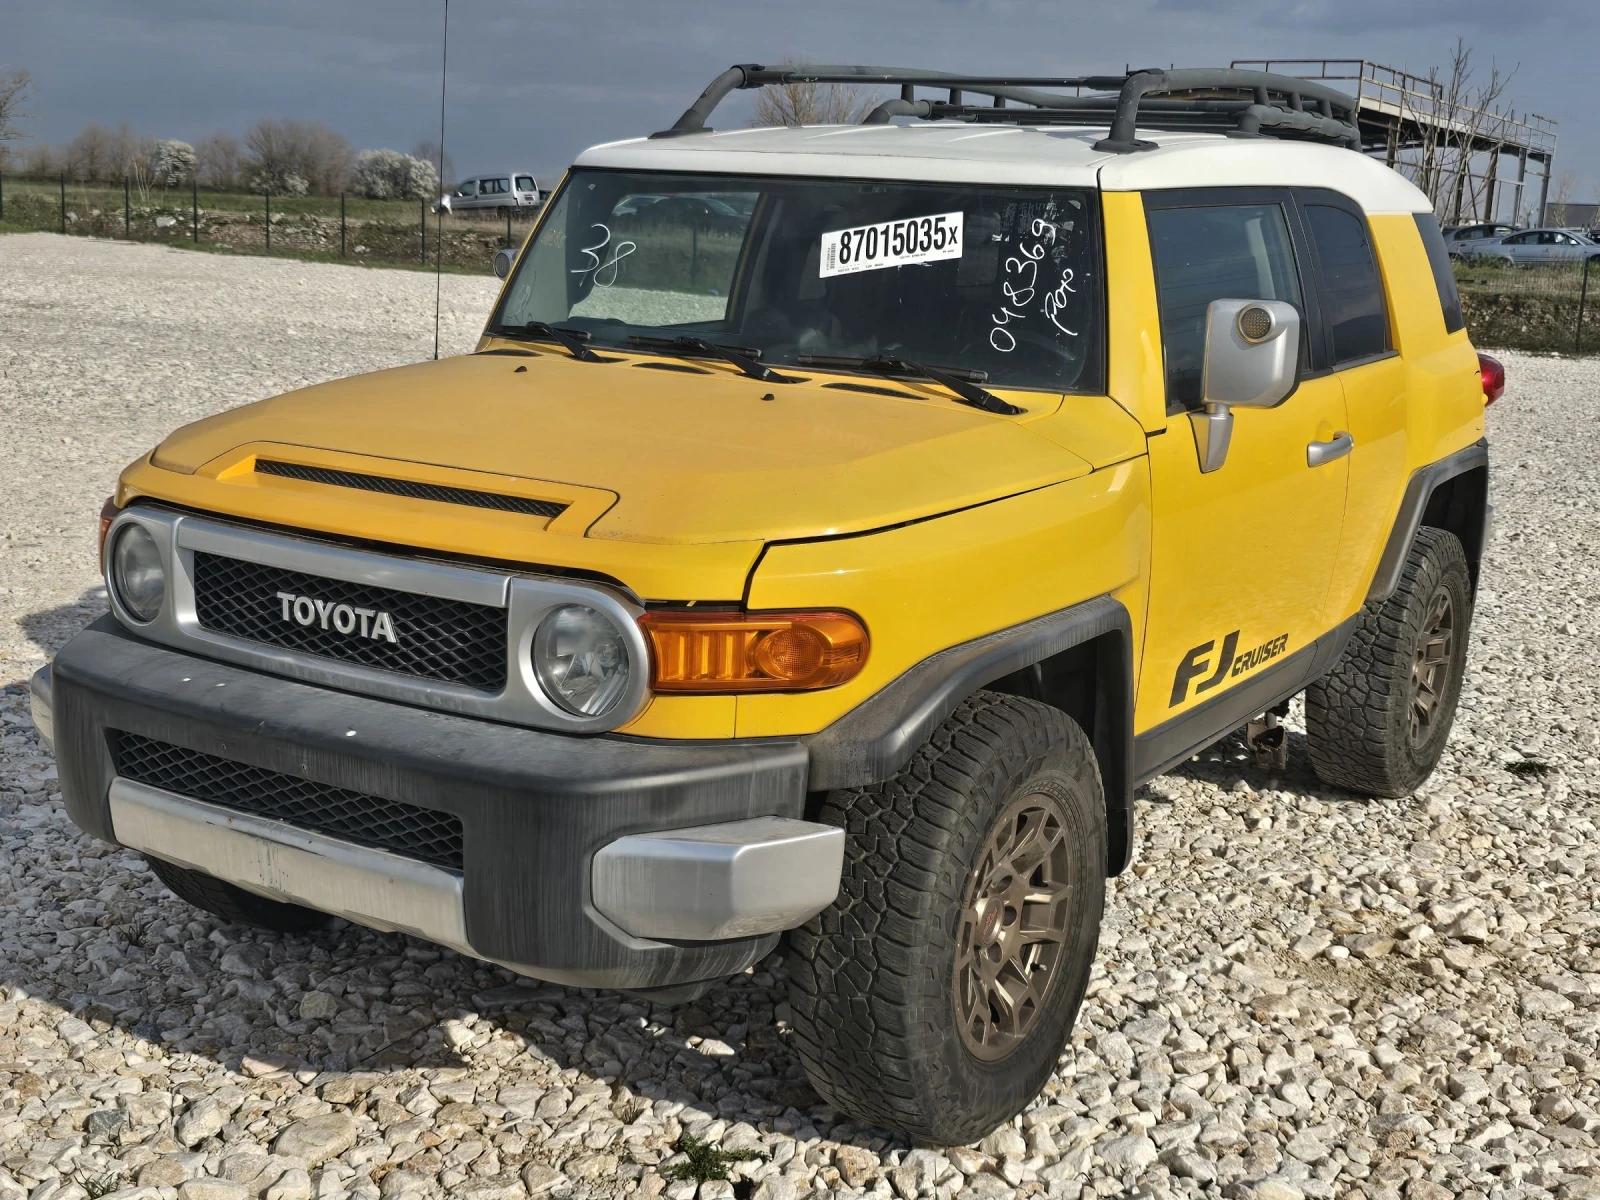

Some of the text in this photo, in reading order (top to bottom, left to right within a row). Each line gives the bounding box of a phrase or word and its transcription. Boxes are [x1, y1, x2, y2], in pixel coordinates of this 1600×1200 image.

[571, 223, 637, 288] 38
[276, 591, 397, 643] TOYOTA
[1168, 629, 1289, 709] FJ CRUISER
